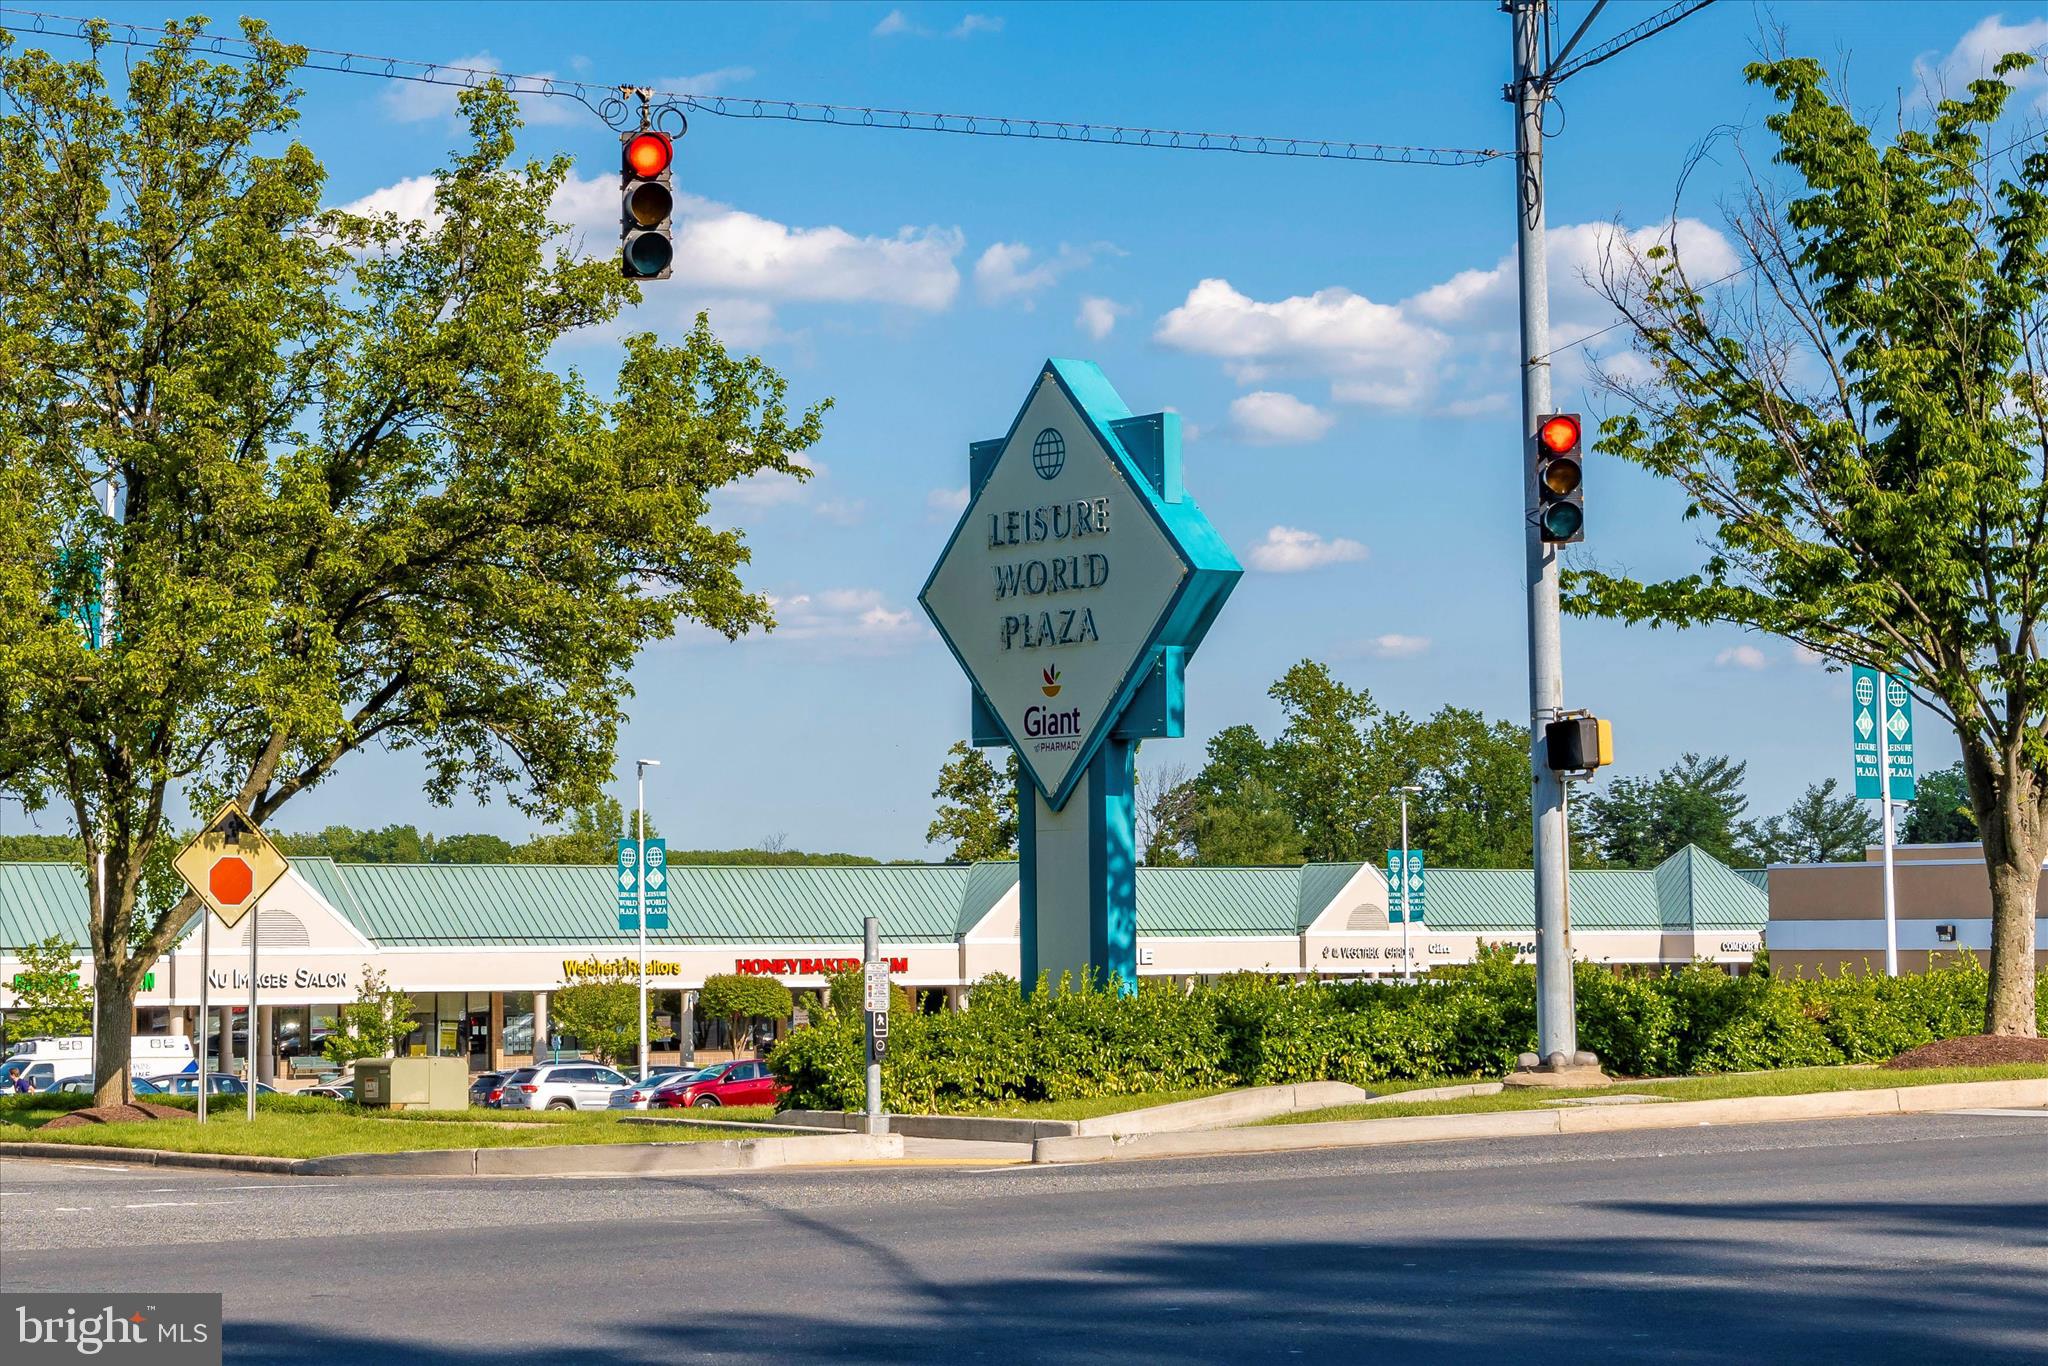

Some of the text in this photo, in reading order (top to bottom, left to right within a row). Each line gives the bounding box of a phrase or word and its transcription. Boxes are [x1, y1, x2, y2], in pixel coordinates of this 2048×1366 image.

[988, 498, 1110, 549] LEISURE
[992, 554, 1109, 600] WORLD
[1001, 607, 1099, 650] PLAZA
[1024, 705, 1081, 737] Giant
[1892, 718, 1906, 731] 10
[1040, 741, 1081, 752] PHARMACY
[1857, 767, 1878, 777] PLAZA
[1888, 767, 1913, 777] PLAZA
[646, 907, 667, 915] PLAZA
